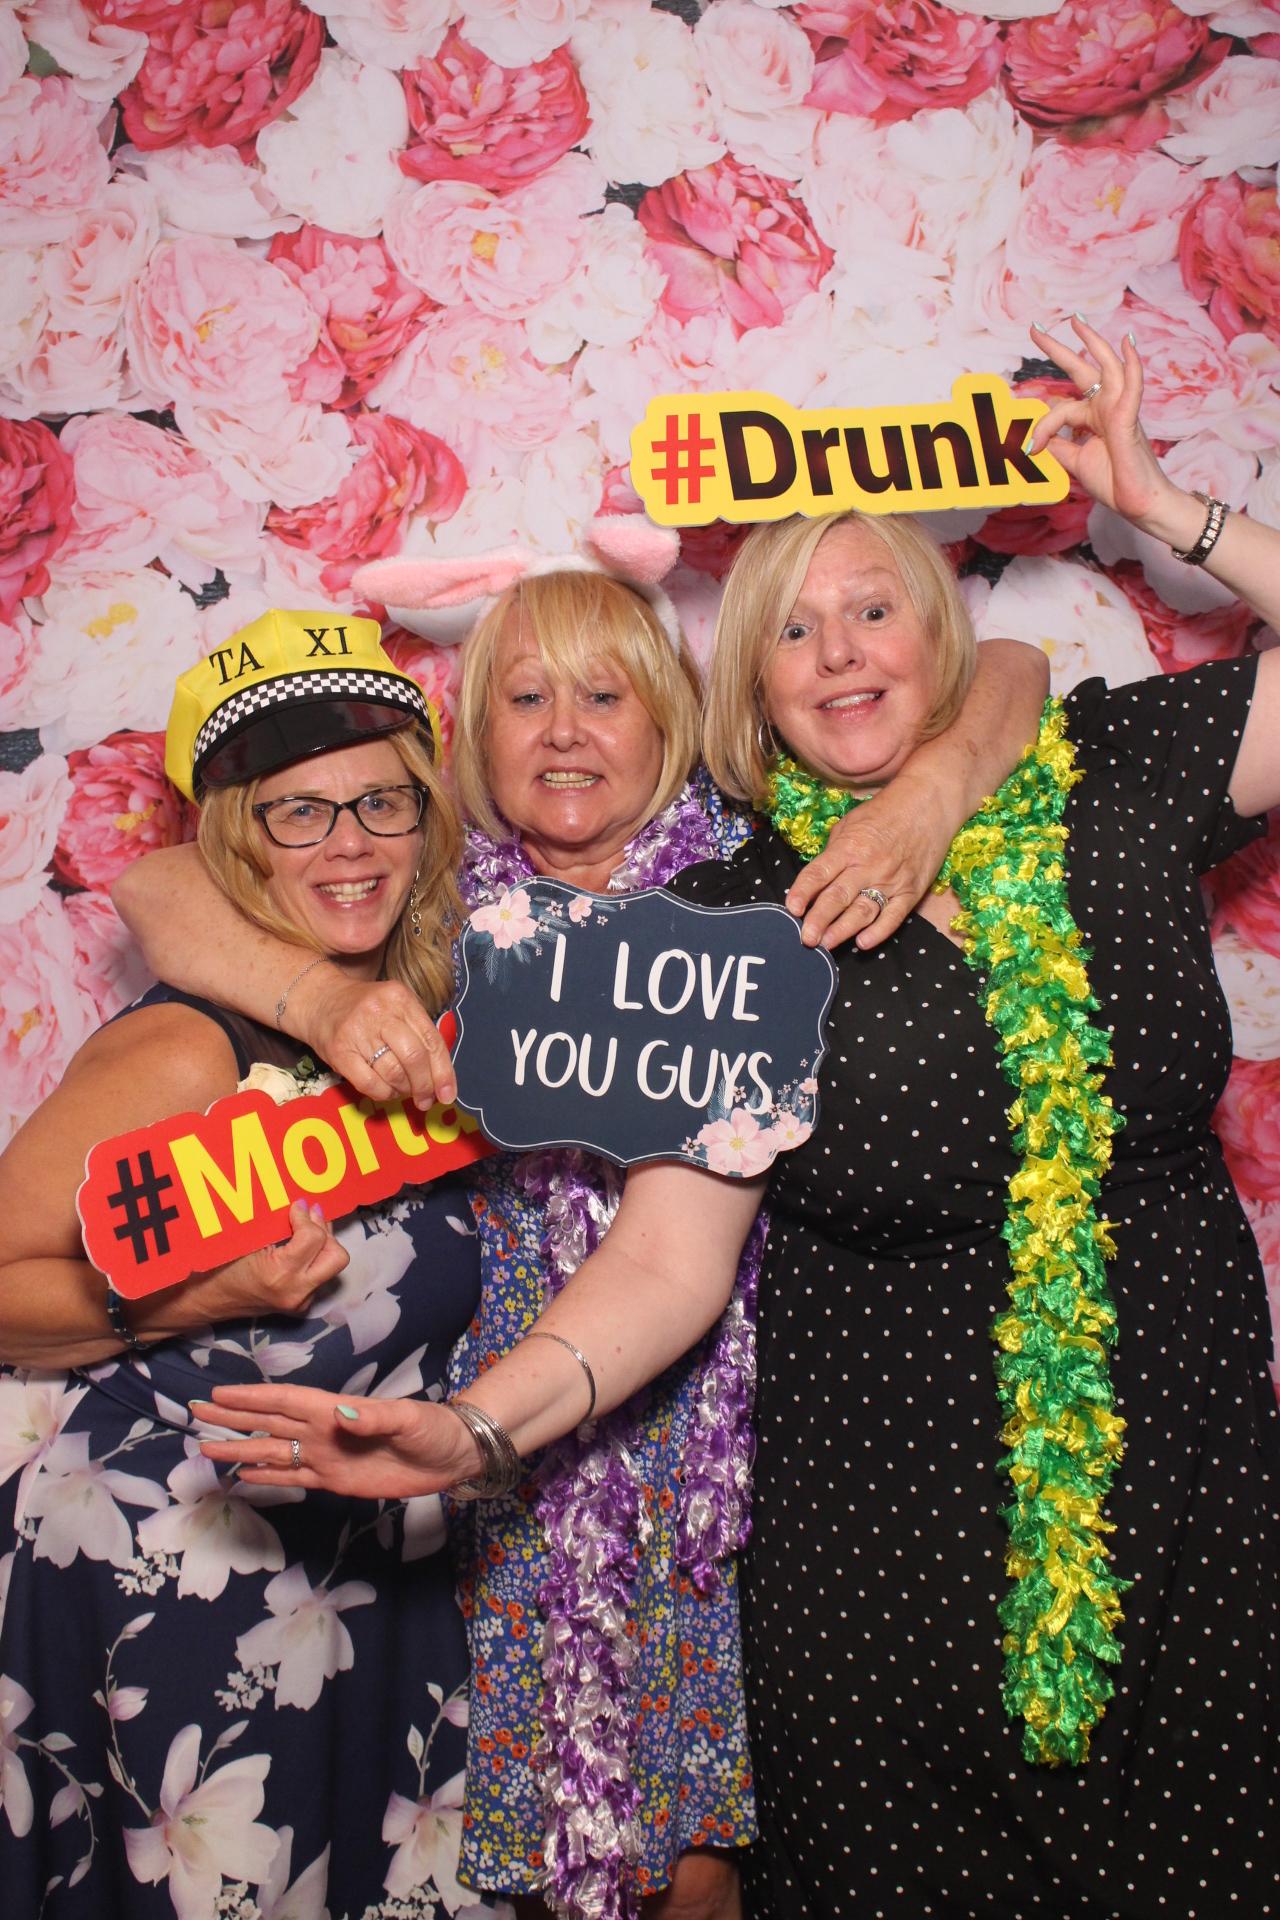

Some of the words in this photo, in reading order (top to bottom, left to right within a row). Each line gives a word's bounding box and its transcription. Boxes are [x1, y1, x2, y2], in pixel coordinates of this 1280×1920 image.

[651, 392, 1049, 504] #Drunk
[550, 934, 566, 1002] I
[613, 941, 765, 1021] LOVE
[511, 1028, 618, 1096] YOU
[636, 1039, 773, 1115] GUYS
